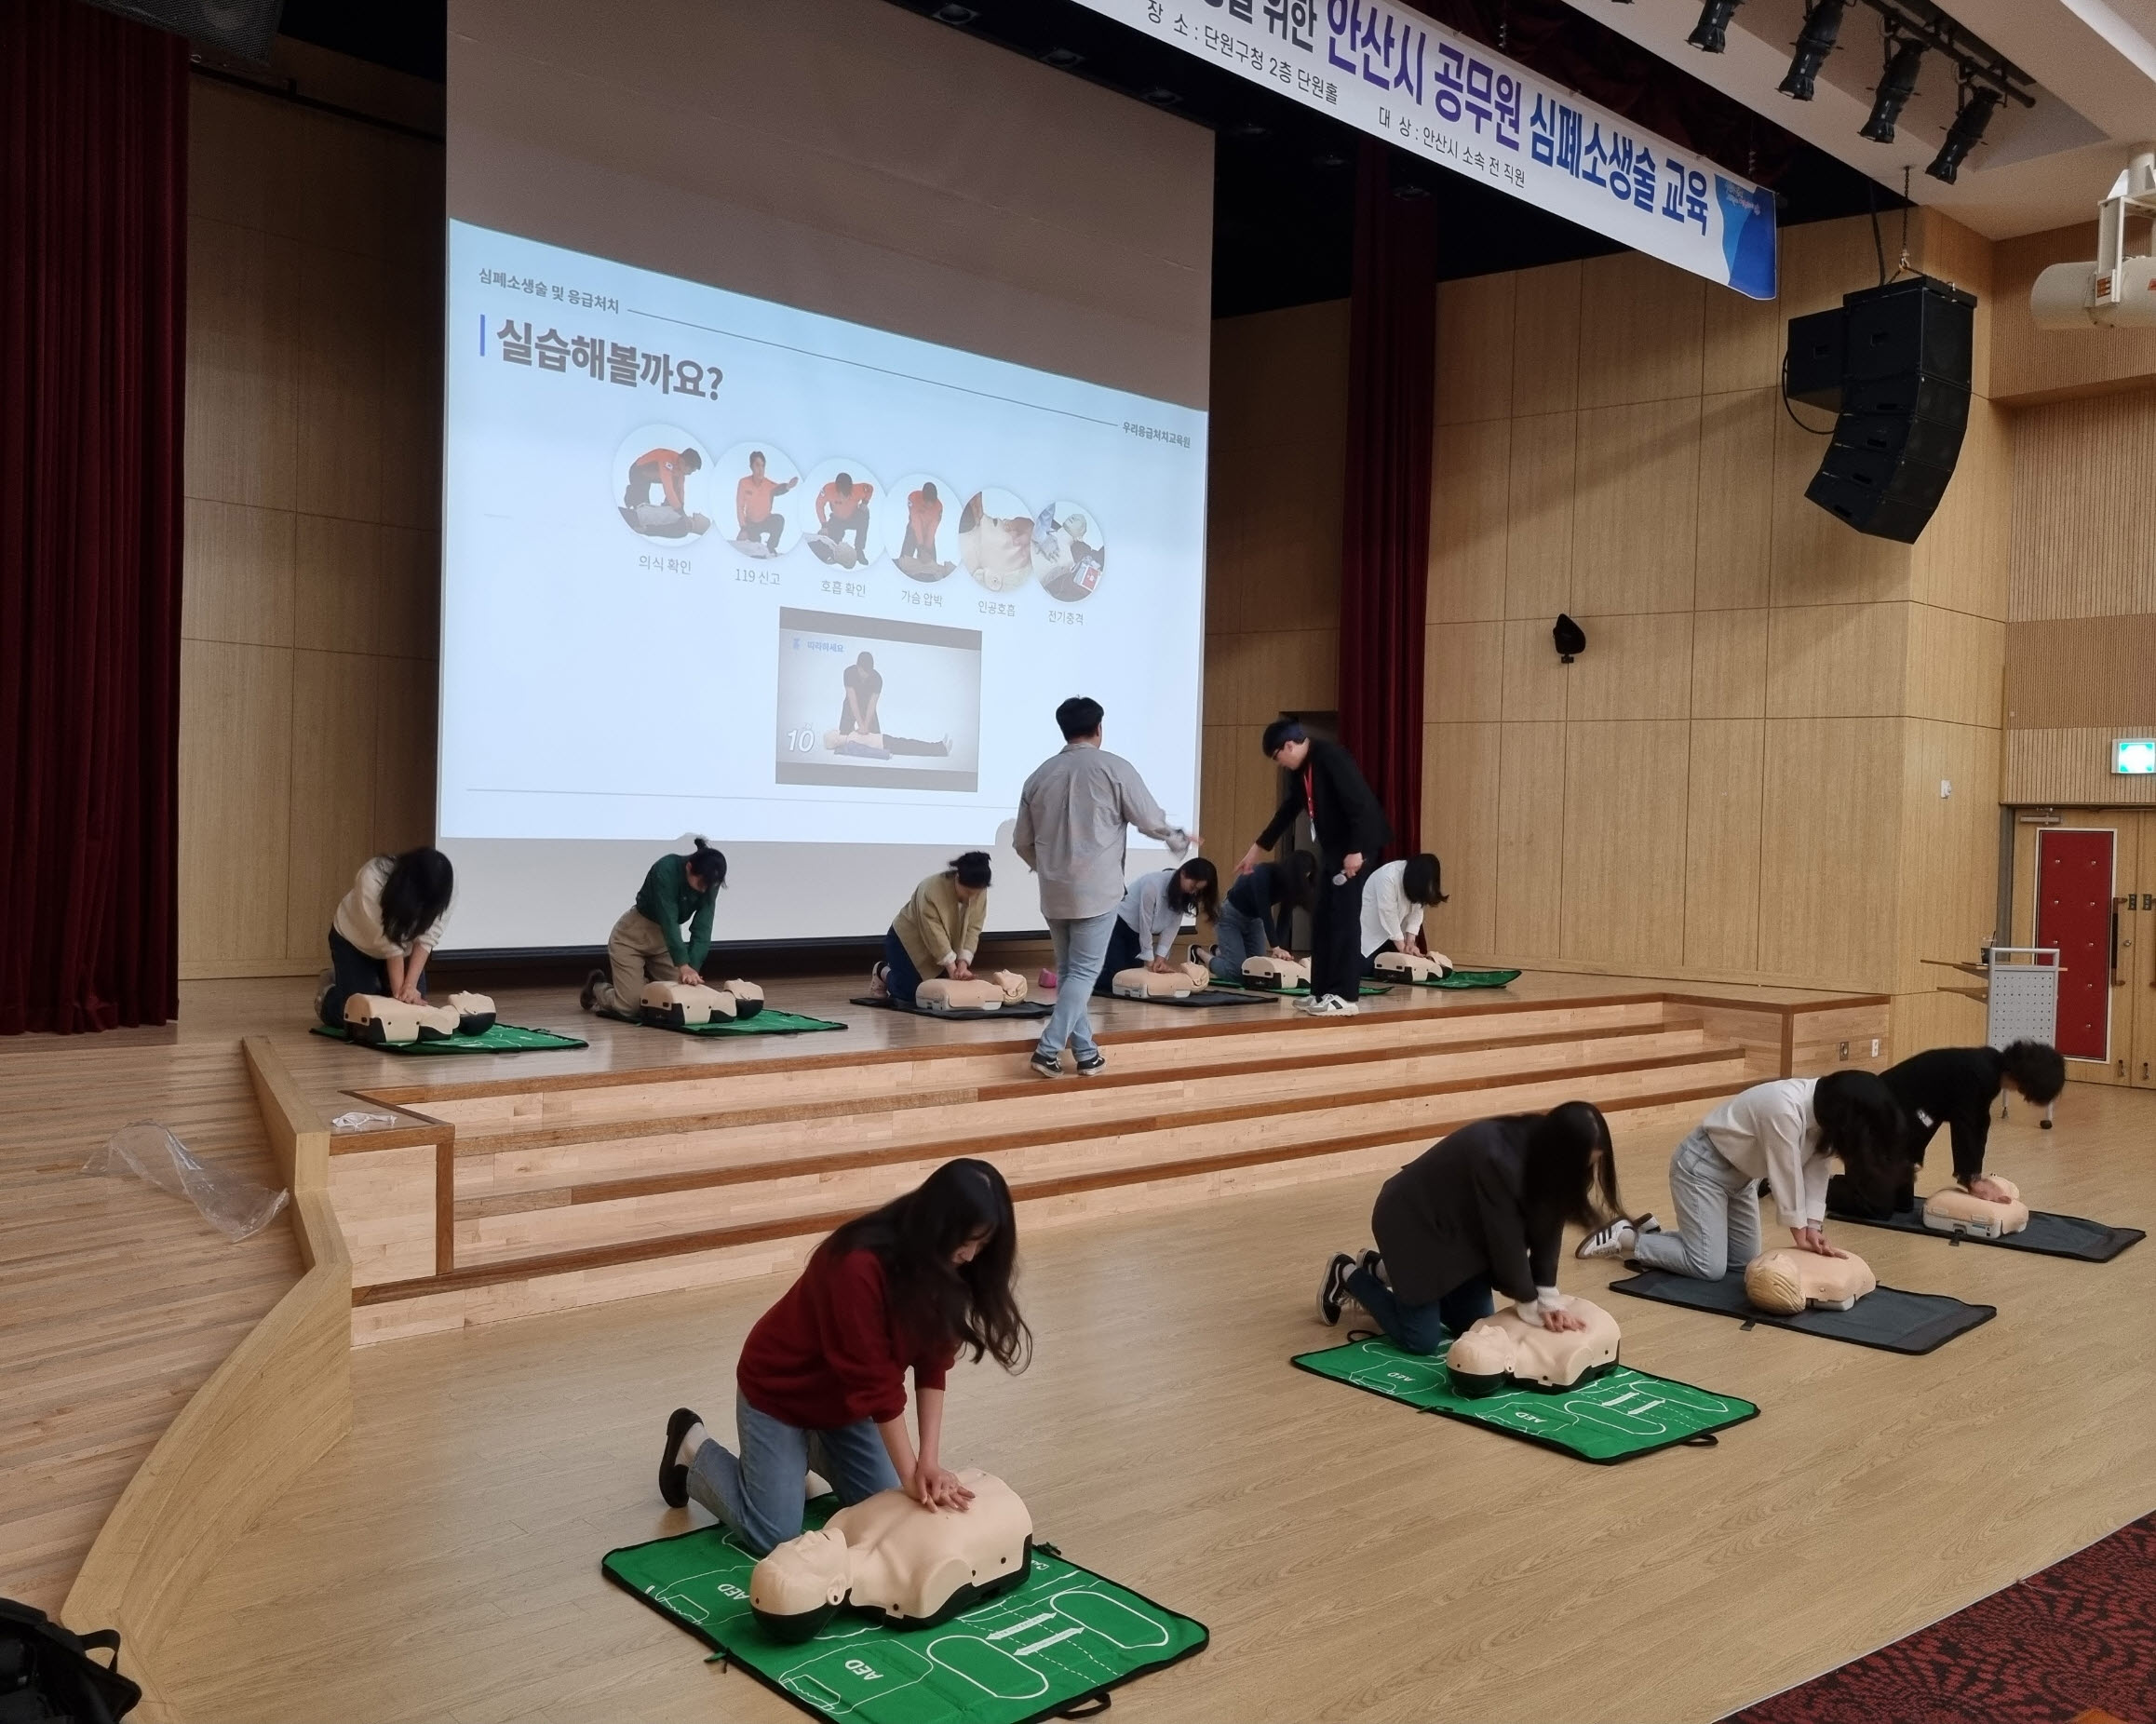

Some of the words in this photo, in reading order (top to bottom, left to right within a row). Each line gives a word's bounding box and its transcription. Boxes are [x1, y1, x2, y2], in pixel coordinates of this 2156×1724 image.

[1147, 0, 1164, 24] 장
[1205, 24, 1263, 71] 단원구청
[1269, 57, 1292, 84] 2층
[1298, 68, 1338, 105] 단원홀
[1262, 0, 1317, 53] 위한
[1327, 0, 1425, 106] 안산시
[1434, 42, 1522, 152] 공무원
[1529, 98, 1656, 213] 심폐소생술
[1662, 158, 1708, 236] 교육
[1379, 105, 1391, 128] 대
[1423, 126, 1459, 159] 안산시
[1462, 146, 1486, 171] 소속
[1489, 156, 1500, 177] 전
[1503, 163, 1526, 189] 직원
[478, 267, 548, 298] 심폐소생술
[551, 285, 564, 302] 및
[568, 290, 620, 315] 응급처치
[496, 318, 724, 401] 실습해볼까요?
[1123, 422, 1191, 449] 우리응급처치교육원
[639, 555, 664, 572] 의식
[667, 558, 692, 575] 확인
[734, 568, 756, 583] 119
[758, 571, 781, 586] 신고
[820, 580, 842, 595] 호흡
[845, 582, 867, 598] 확인
[901, 589, 922, 605] 가슴
[923, 592, 943, 608] 압박
[977, 599, 1016, 617] 인공호흡
[1047, 610, 1085, 626] 전기충격
[788, 729, 815, 753] 10
[1516, 1411, 1547, 1423] AED
[717, 1583, 750, 1600] AED
[844, 1659, 884, 1680] AED
